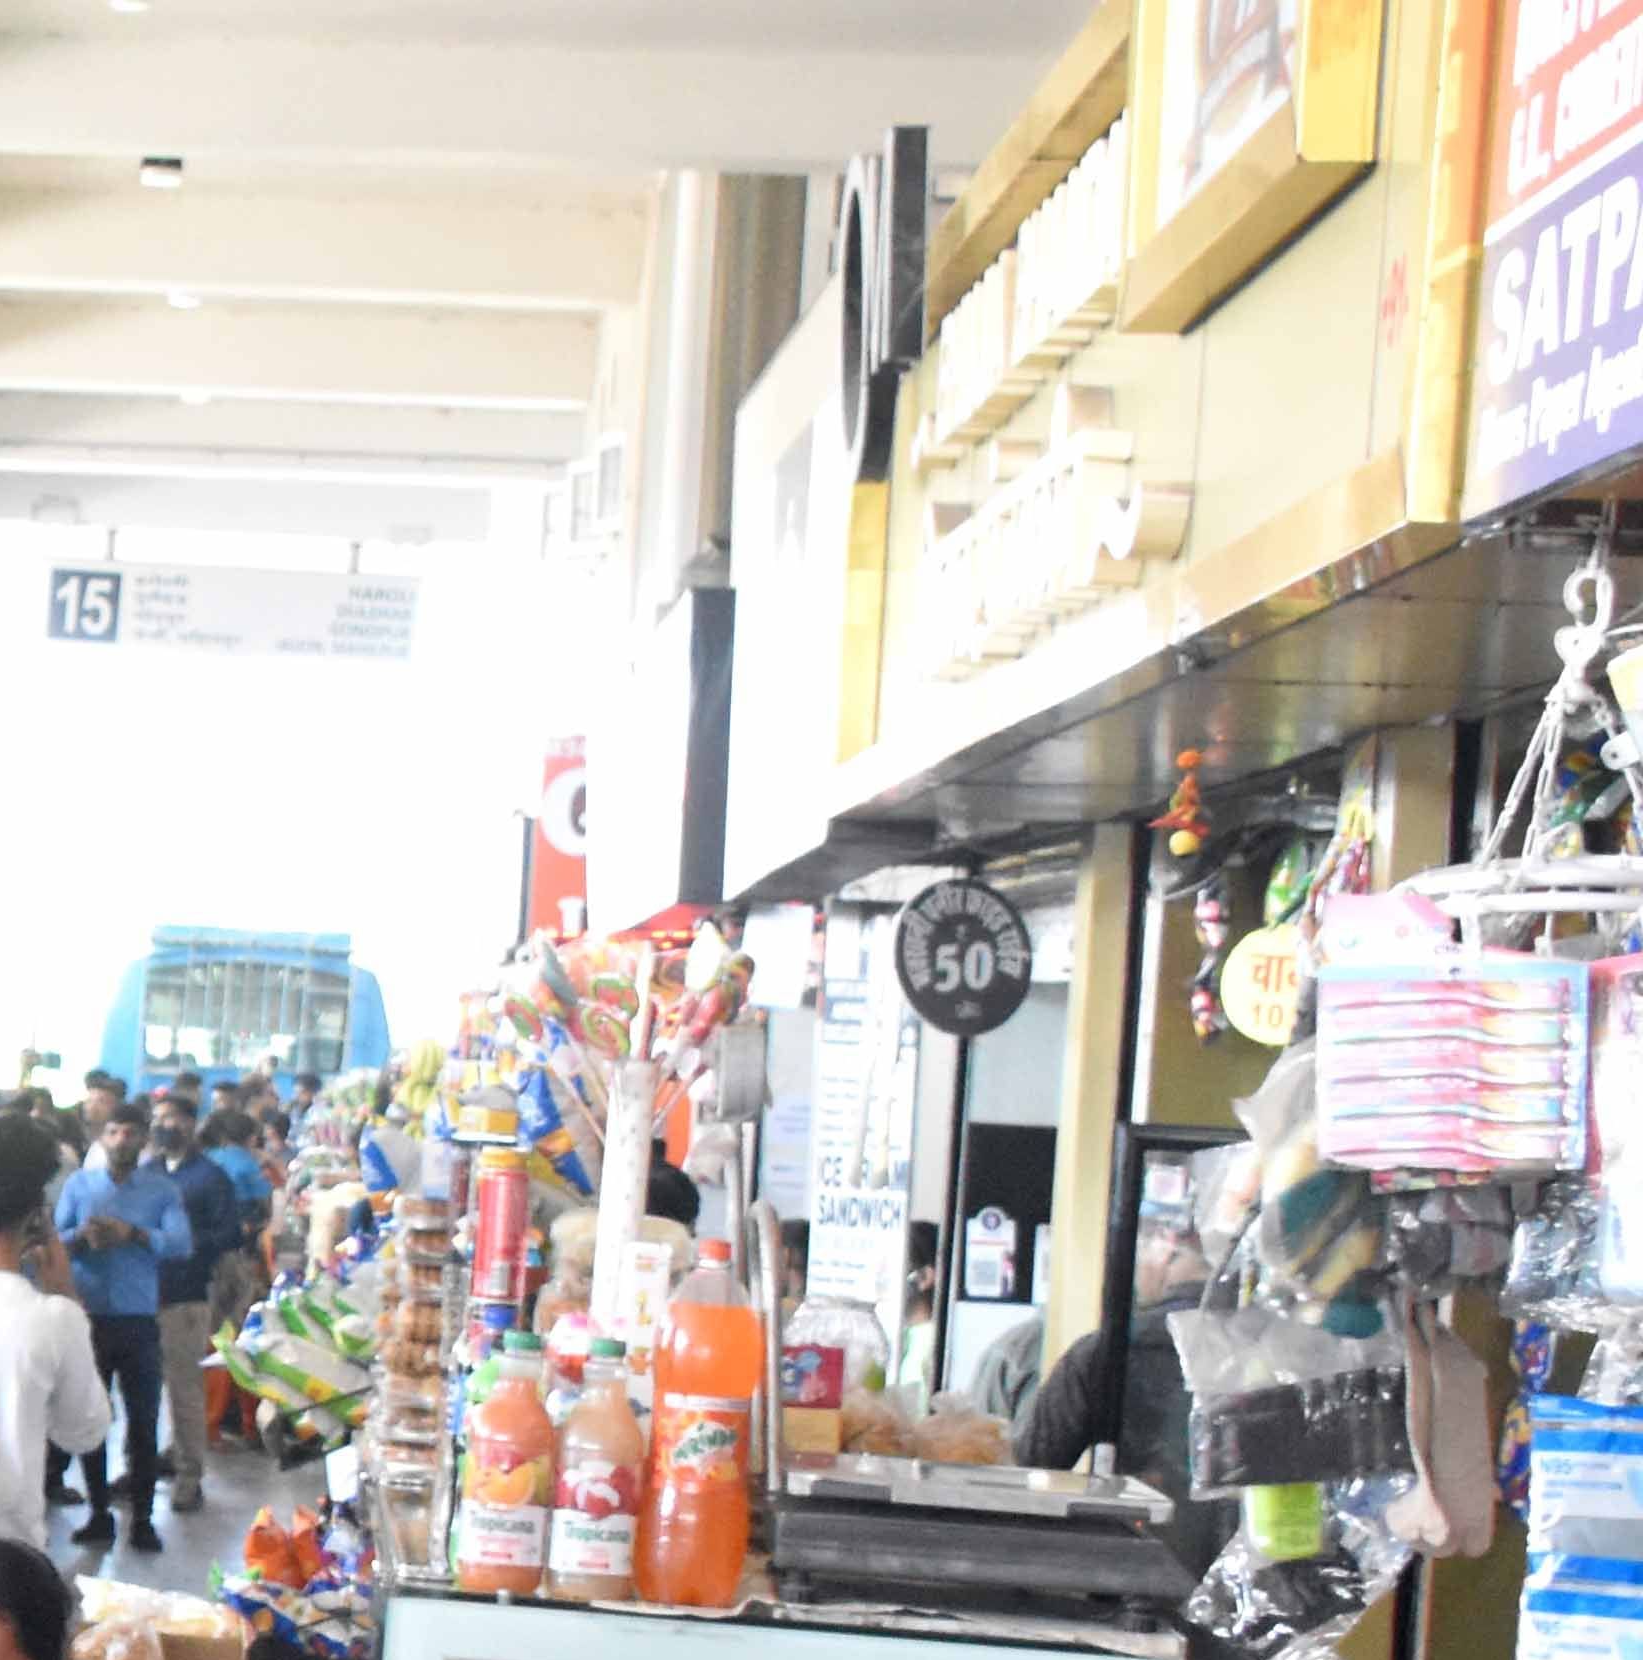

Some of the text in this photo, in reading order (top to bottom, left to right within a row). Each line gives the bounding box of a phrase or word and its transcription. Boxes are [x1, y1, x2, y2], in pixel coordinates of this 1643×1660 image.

[55, 575, 114, 637] 15
[934, 941, 995, 993] 50
[818, 1193, 903, 1232] SANDWICH
